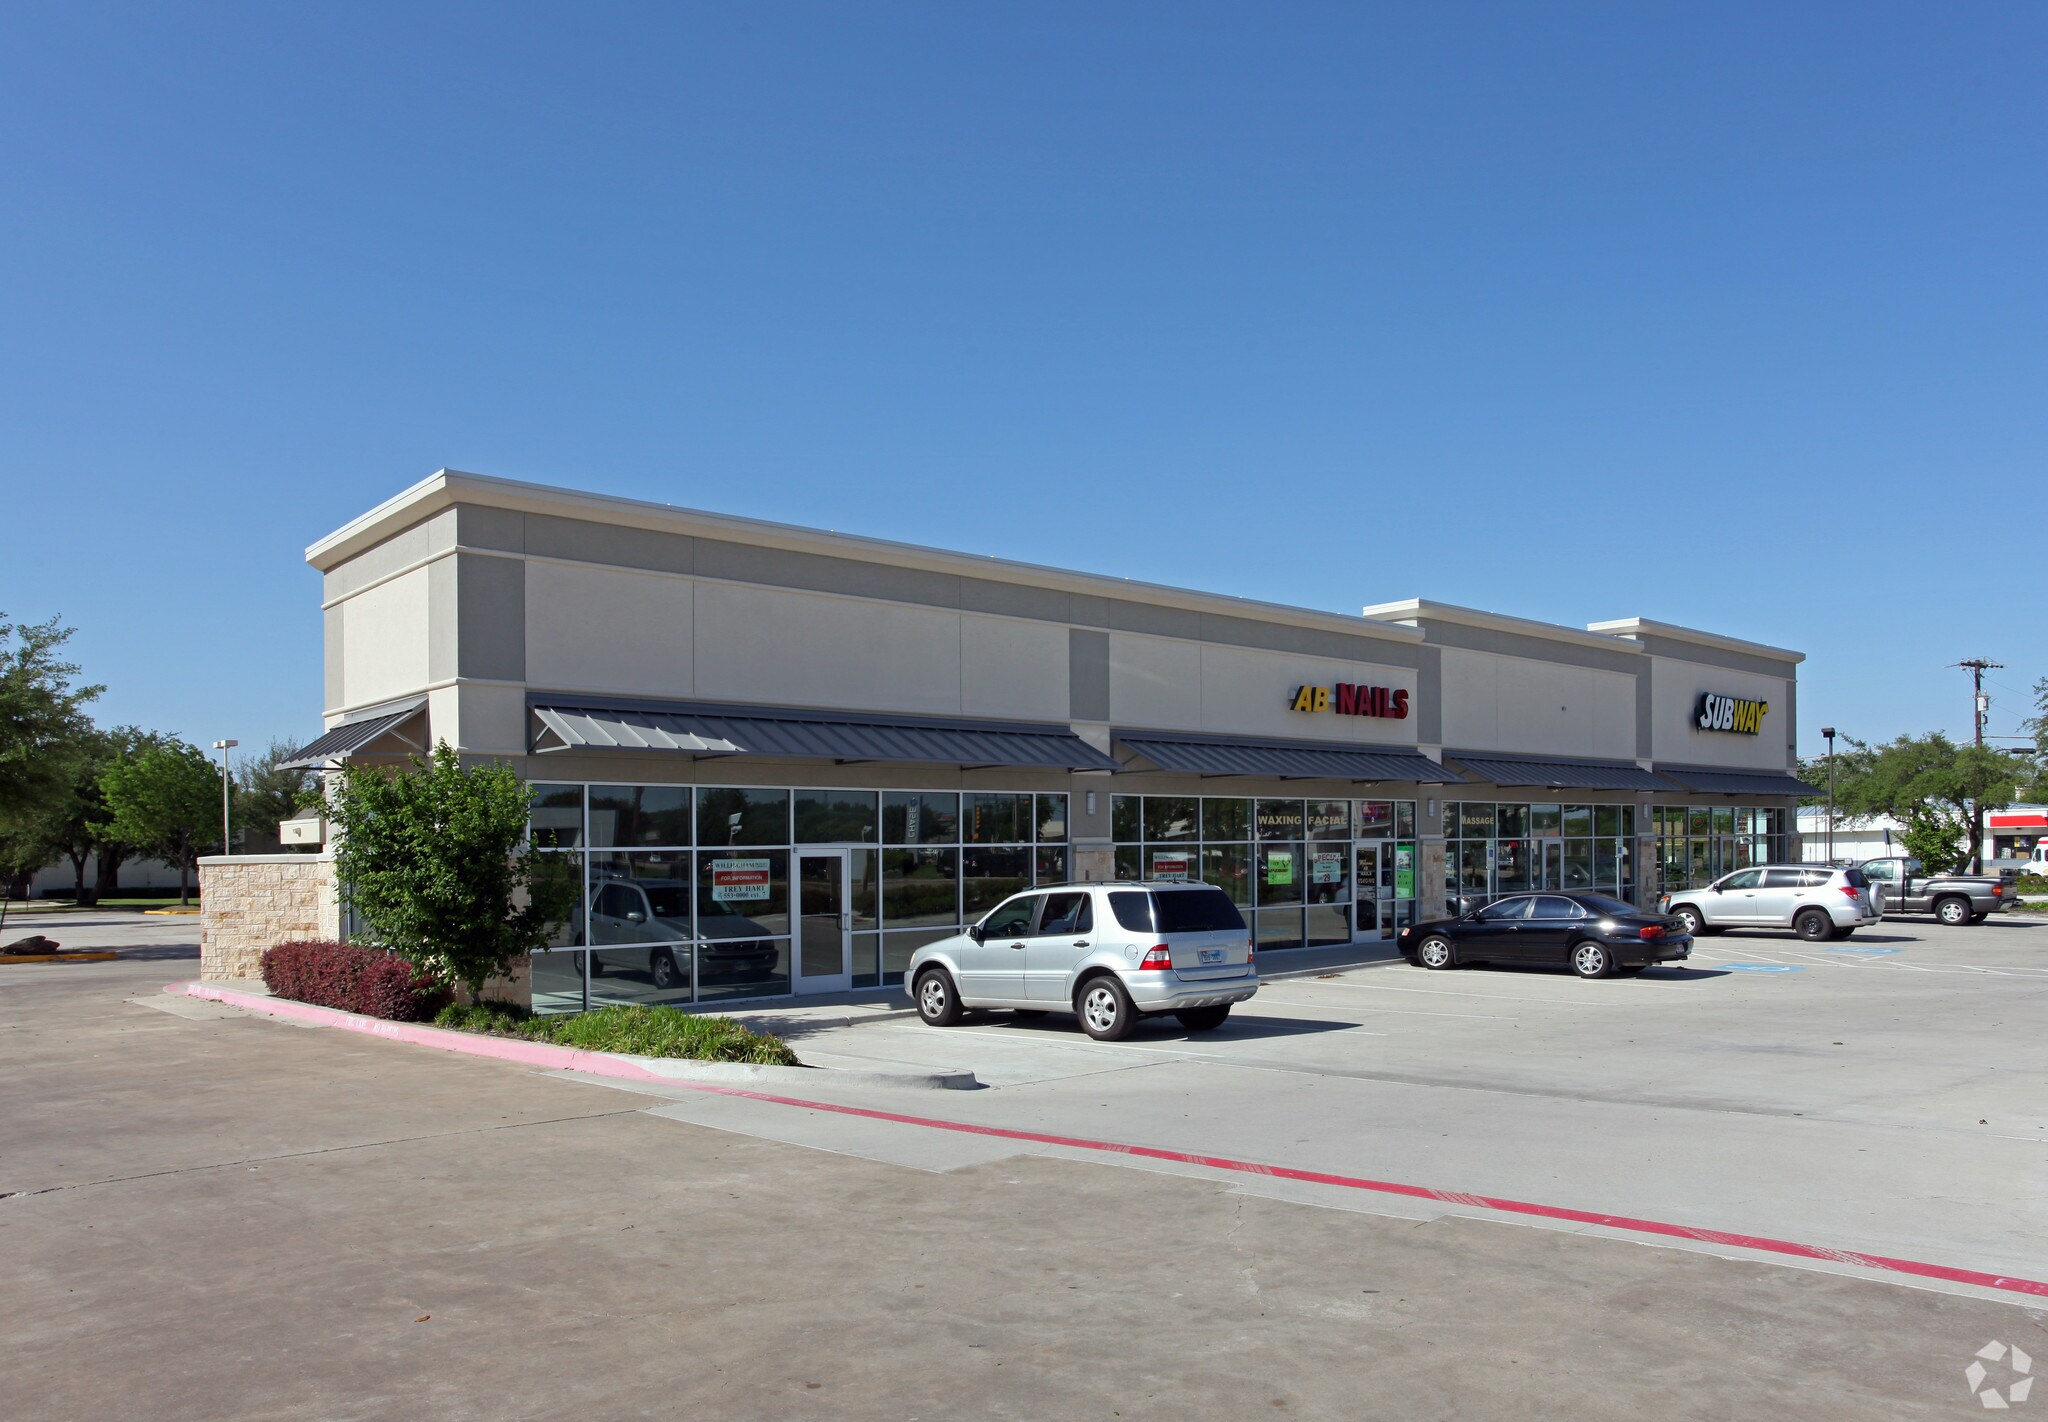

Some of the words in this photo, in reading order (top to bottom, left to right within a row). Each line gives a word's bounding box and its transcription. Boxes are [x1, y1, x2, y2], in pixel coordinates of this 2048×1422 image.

[1290, 684, 1331, 712] AB
[1335, 682, 1409, 720] NAILS
[1699, 693, 1770, 733] SUBWAY
[1257, 815, 1302, 825] WAXING
[1307, 815, 1348, 825] FACIAL
[1461, 816, 1495, 825] MASSAGE
[724, 885, 742, 893] TREY
